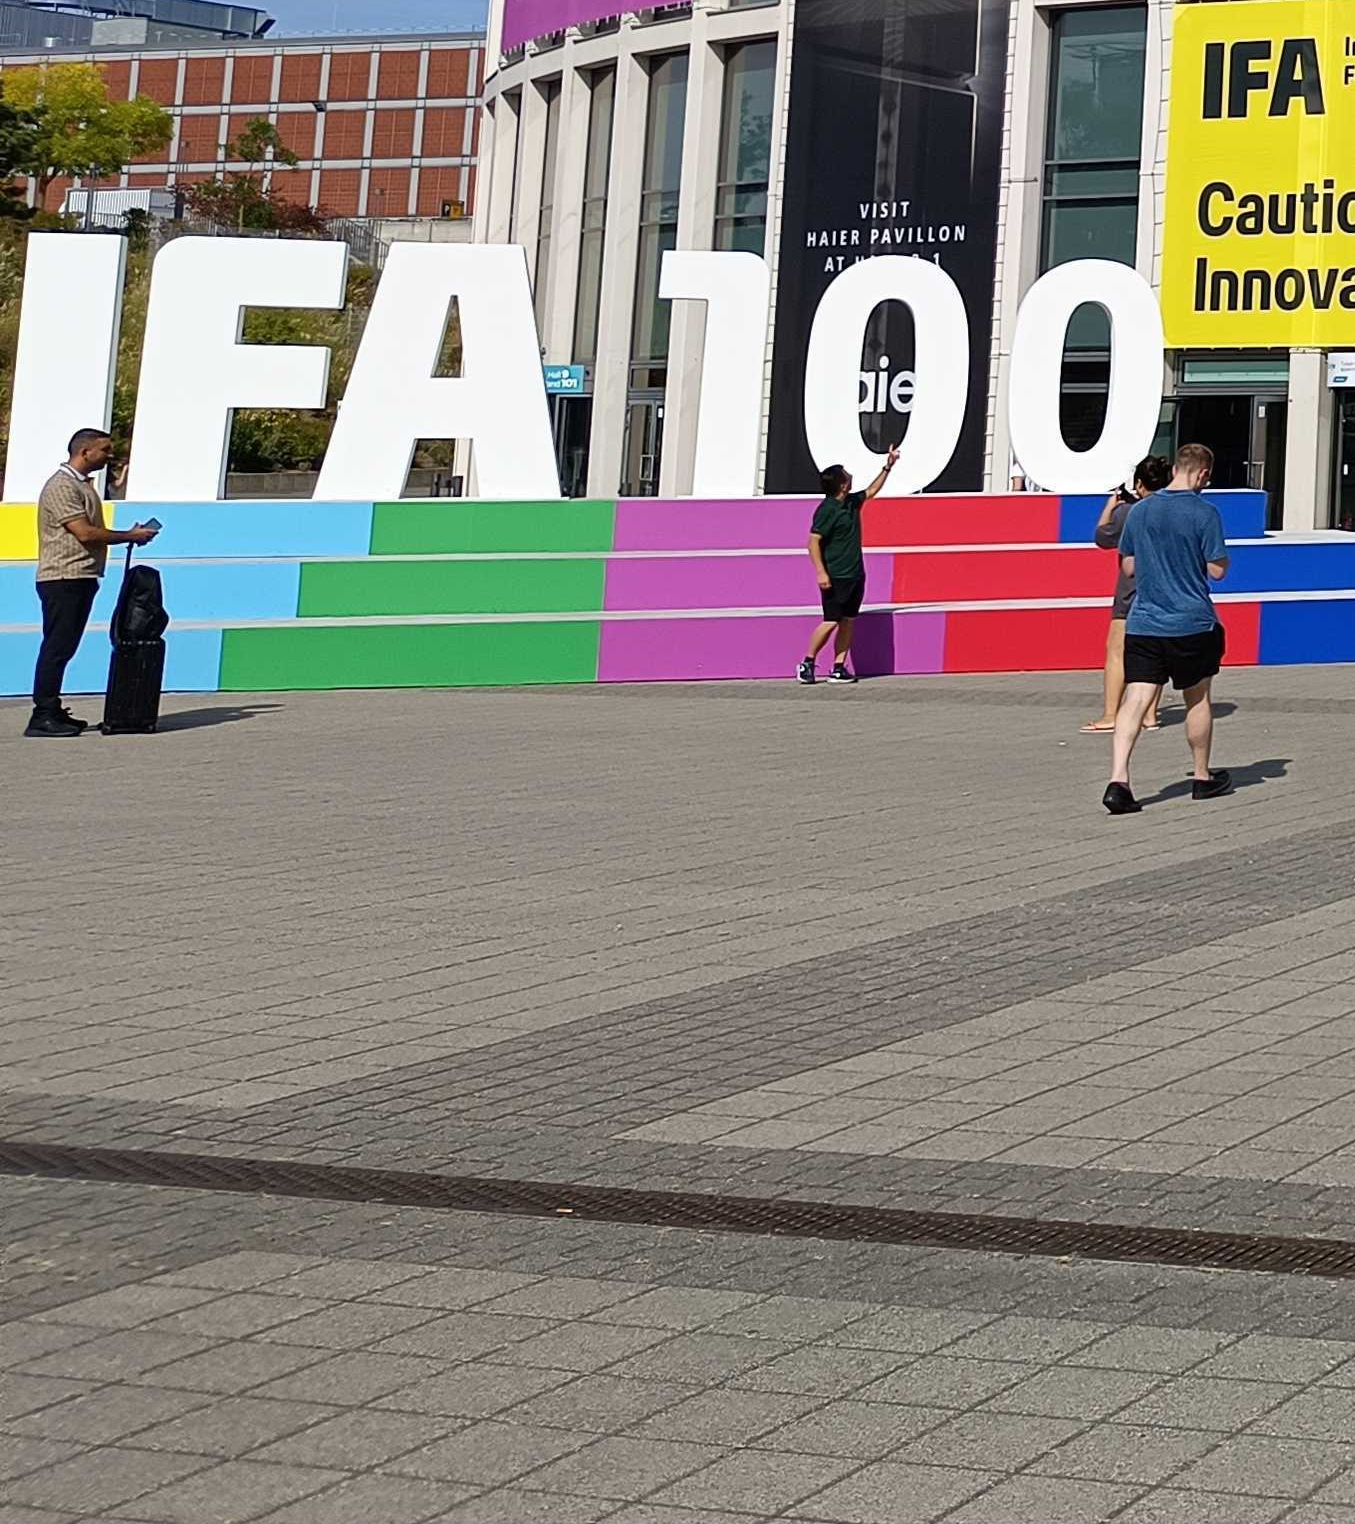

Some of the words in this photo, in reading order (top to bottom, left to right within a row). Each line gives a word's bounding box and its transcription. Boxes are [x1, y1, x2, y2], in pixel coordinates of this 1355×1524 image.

[1202, 38, 1326, 120] IFA
[859, 200, 911, 220] VISIT
[806, 228, 861, 248] HAIER
[870, 224, 966, 246] PAVILLON
[824, 256, 845, 273] AT
[3, 231, 570, 502] IFA
[658, 250, 1165, 497] 100
[561, 379, 578, 388] 101
